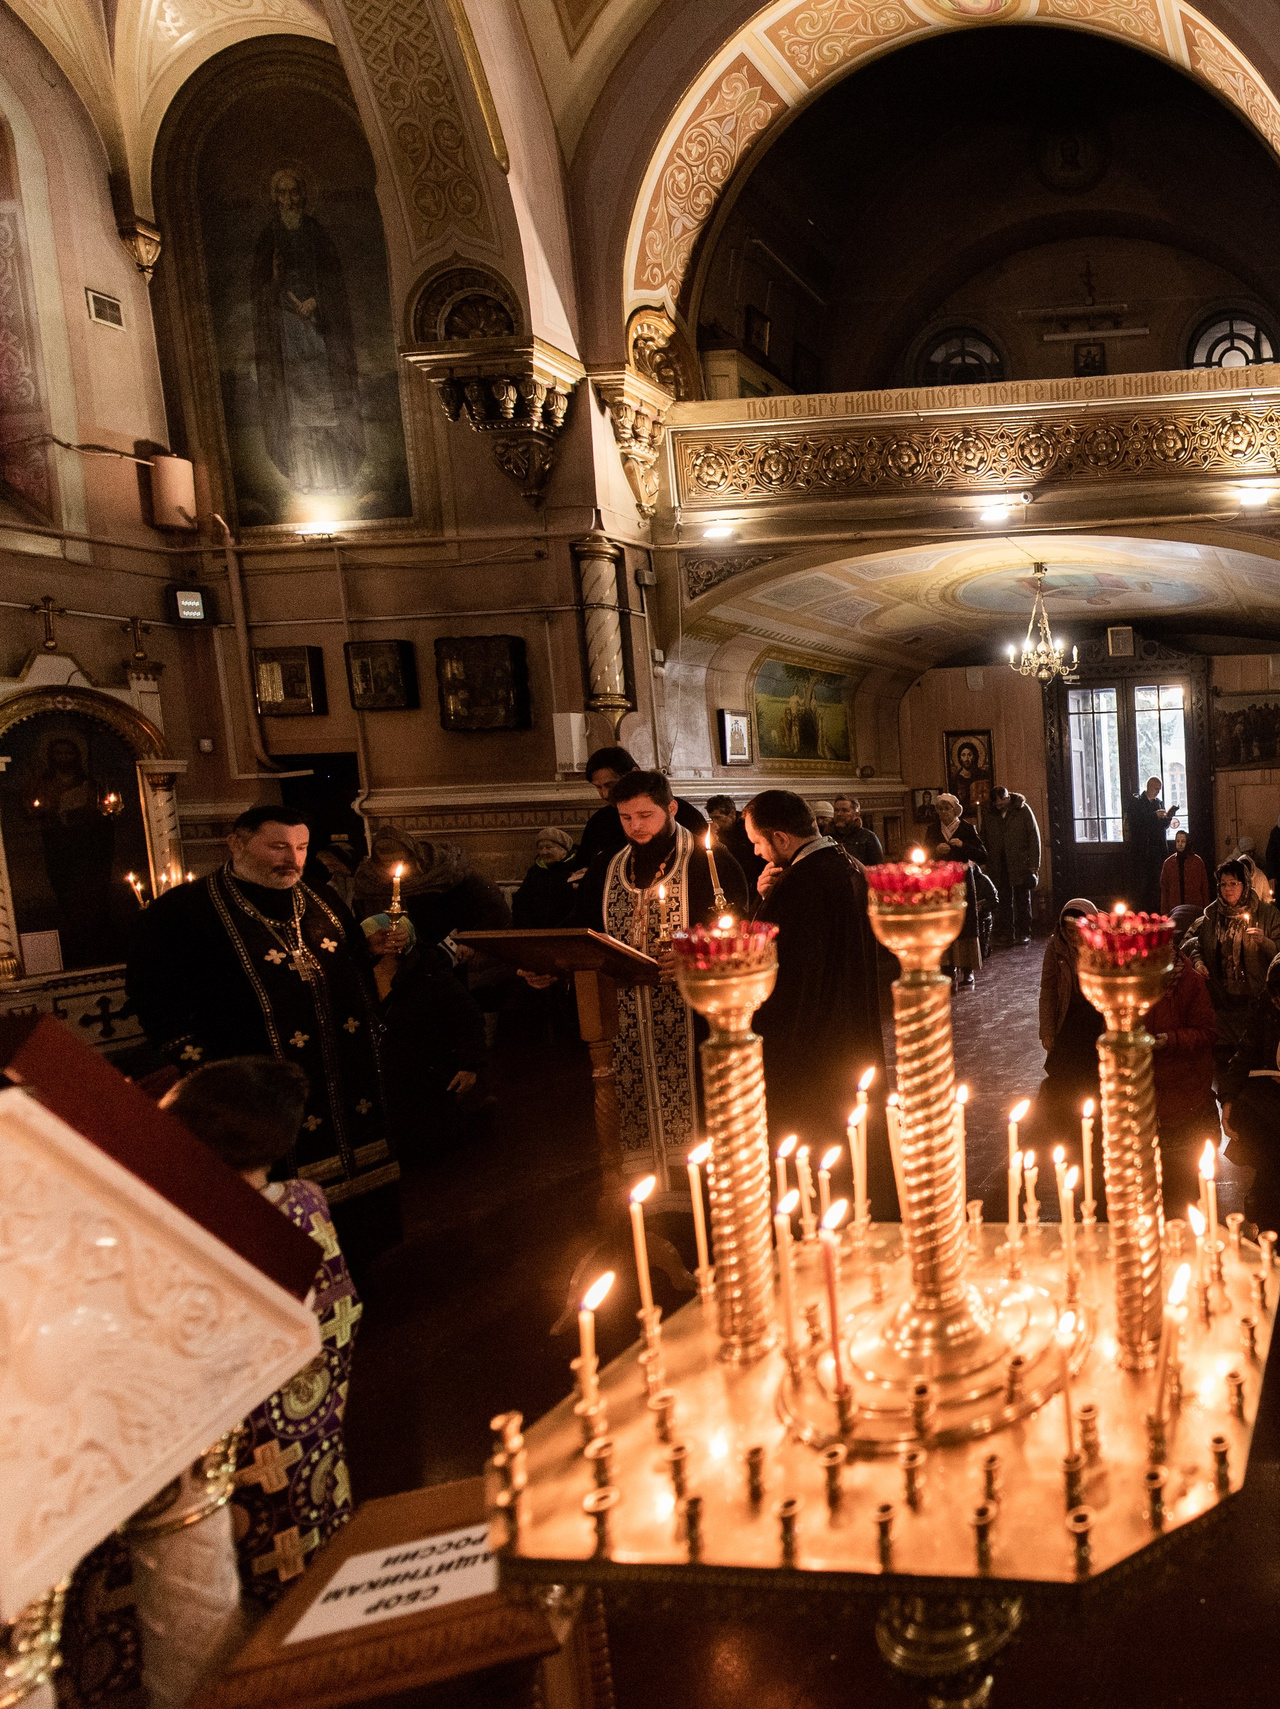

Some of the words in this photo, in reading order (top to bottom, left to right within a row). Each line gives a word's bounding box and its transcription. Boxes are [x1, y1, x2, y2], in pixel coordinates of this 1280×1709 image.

[380, 1532, 488, 1569] РОССИИ
[321, 1551, 497, 1604] АЩИТНИКАМ
[364, 1585, 440, 1615] СБОР
